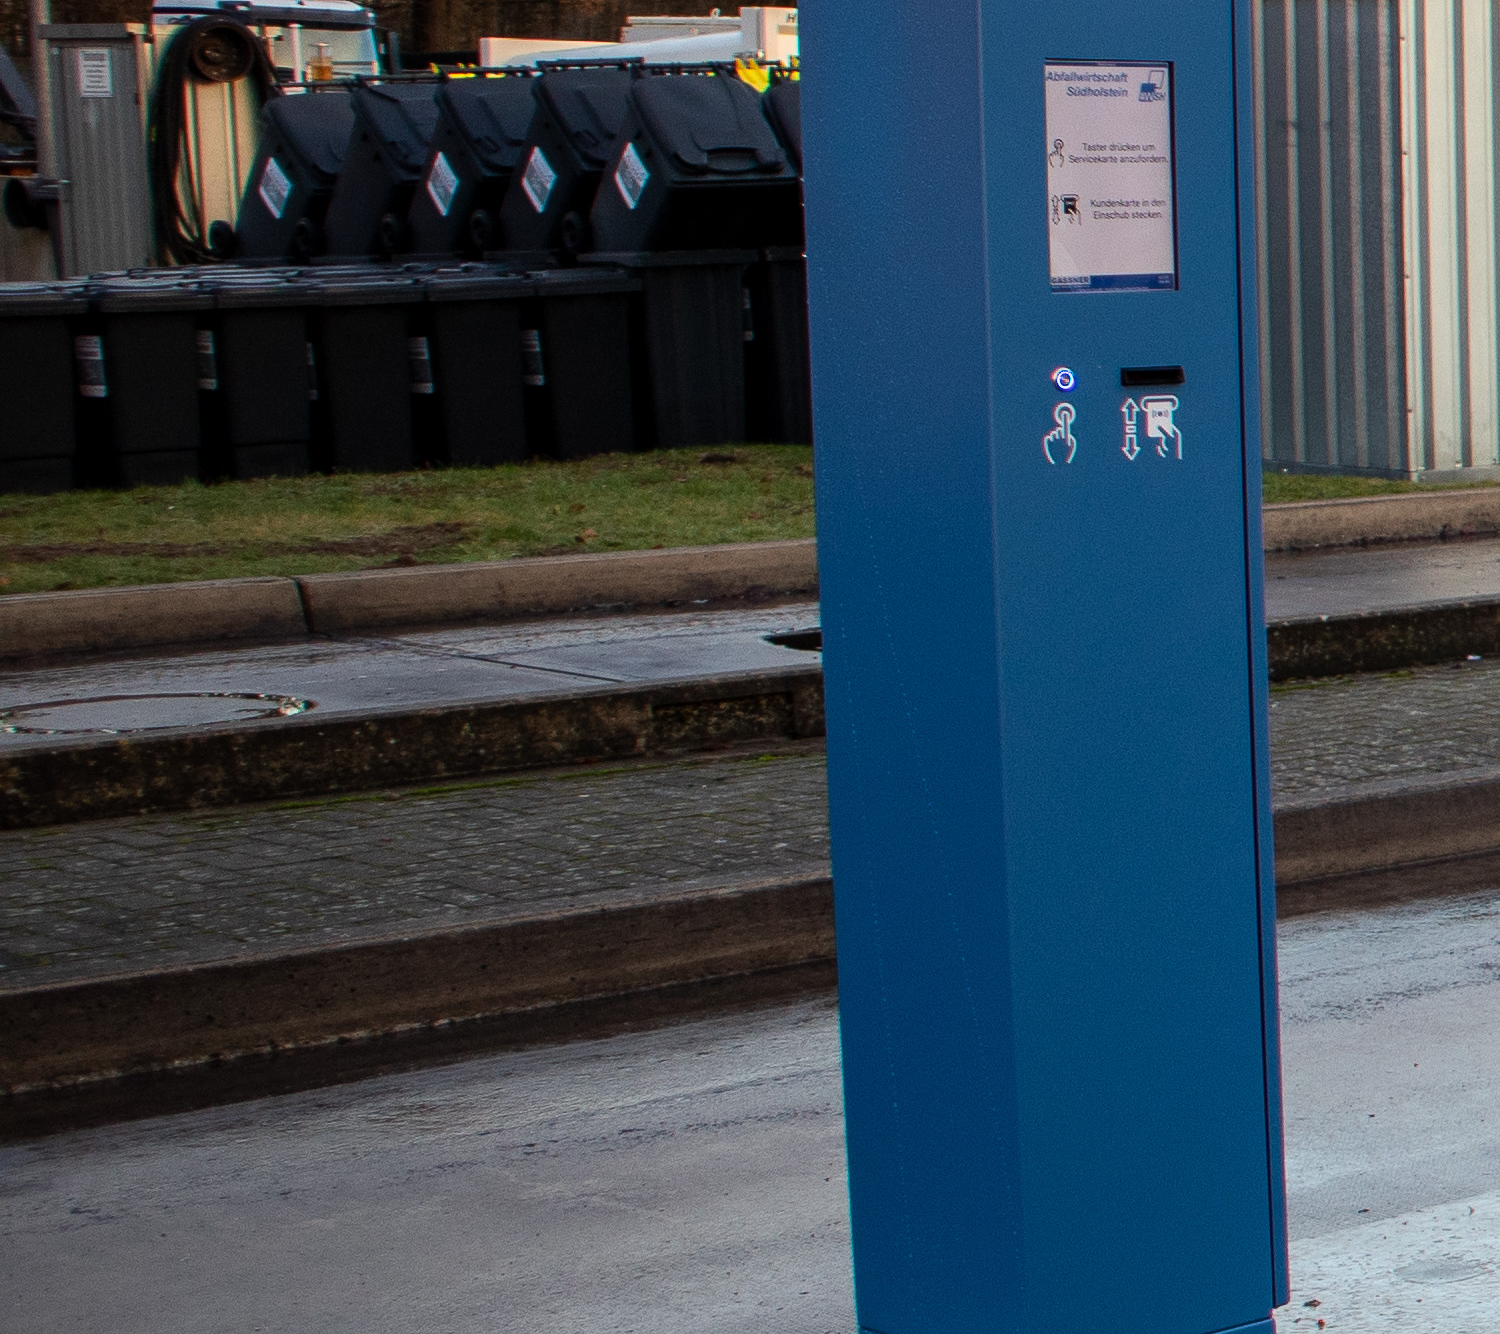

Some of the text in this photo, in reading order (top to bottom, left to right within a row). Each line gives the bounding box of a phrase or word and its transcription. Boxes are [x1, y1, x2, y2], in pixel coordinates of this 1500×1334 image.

[1045, 71, 1128, 83] Abfallwirtschaft
[1066, 86, 1129, 98] Südholstein
[1081, 142, 1107, 151] Taster
[1109, 142, 1140, 151] drücken
[1068, 154, 1119, 164] Servicekarte
[1090, 199, 1140, 208] Kundenkarte
[1151, 199, 1166, 207] den
[1093, 211, 1130, 220] Einschub
[1051, 276, 1090, 284] GASSNER
